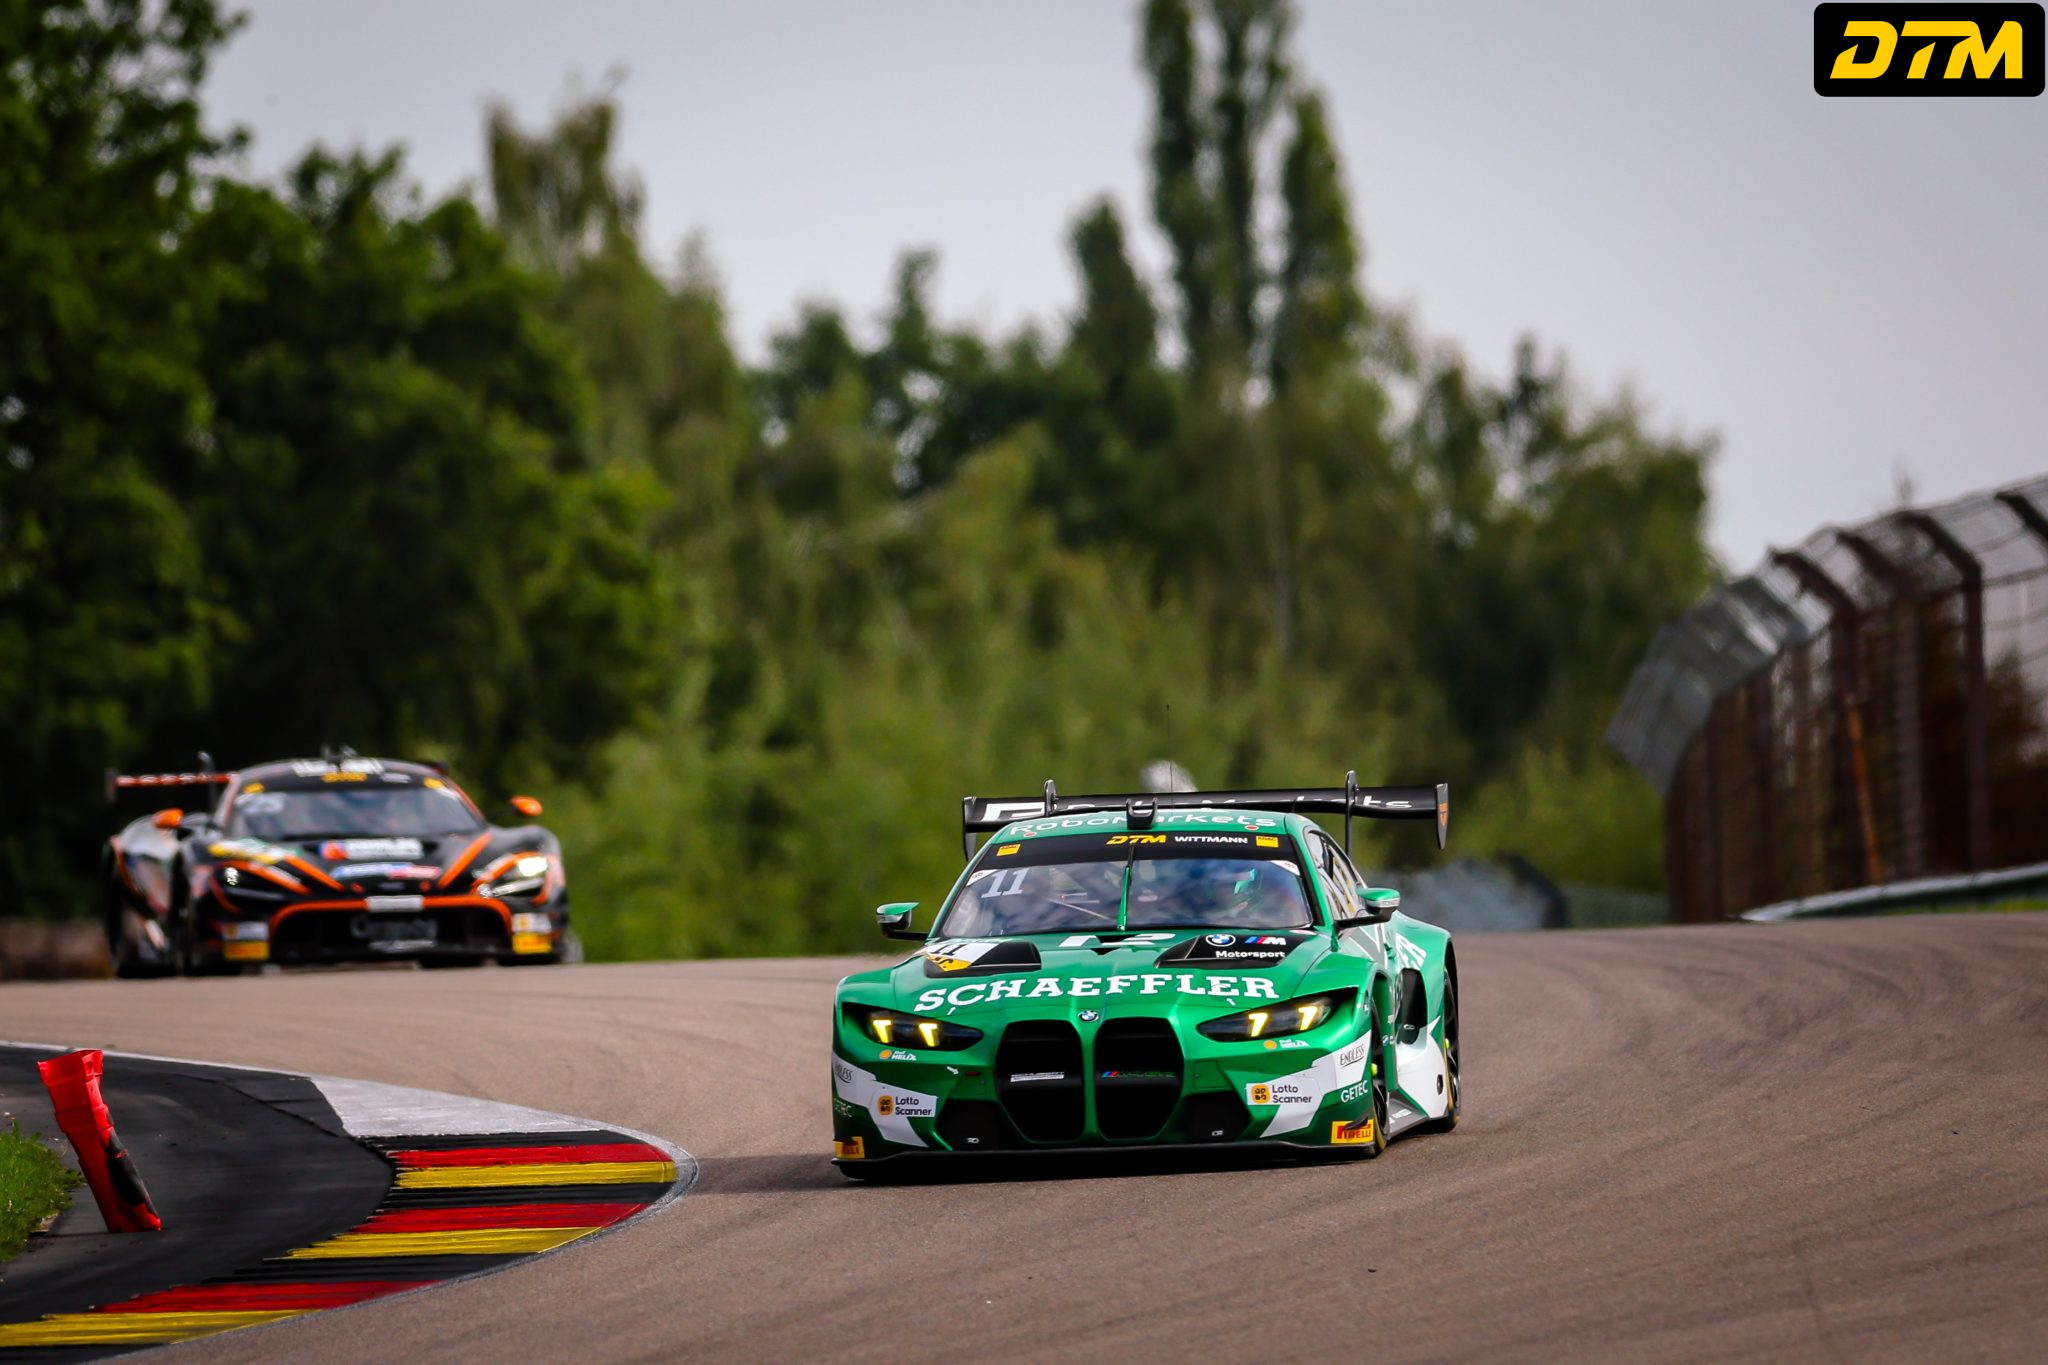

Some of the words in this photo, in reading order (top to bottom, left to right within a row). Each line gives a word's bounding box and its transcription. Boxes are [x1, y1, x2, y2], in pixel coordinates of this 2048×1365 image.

[1106, 834, 1167, 845] DTM
[1174, 835, 1248, 844] WITTMANN
[981, 868, 1029, 899] 11
[1215, 950, 1286, 959] Motorsport
[914, 974, 1280, 1012] SCHAEFFLER
[1340, 1044, 1365, 1067] ENDLESS
[1272, 1085, 1299, 1094] Lotto
[1341, 1080, 1369, 1103] GETEC
[895, 1097, 919, 1106] Lotto
[1272, 1095, 1312, 1104] Scanner
[895, 1106, 932, 1116] Scanner
